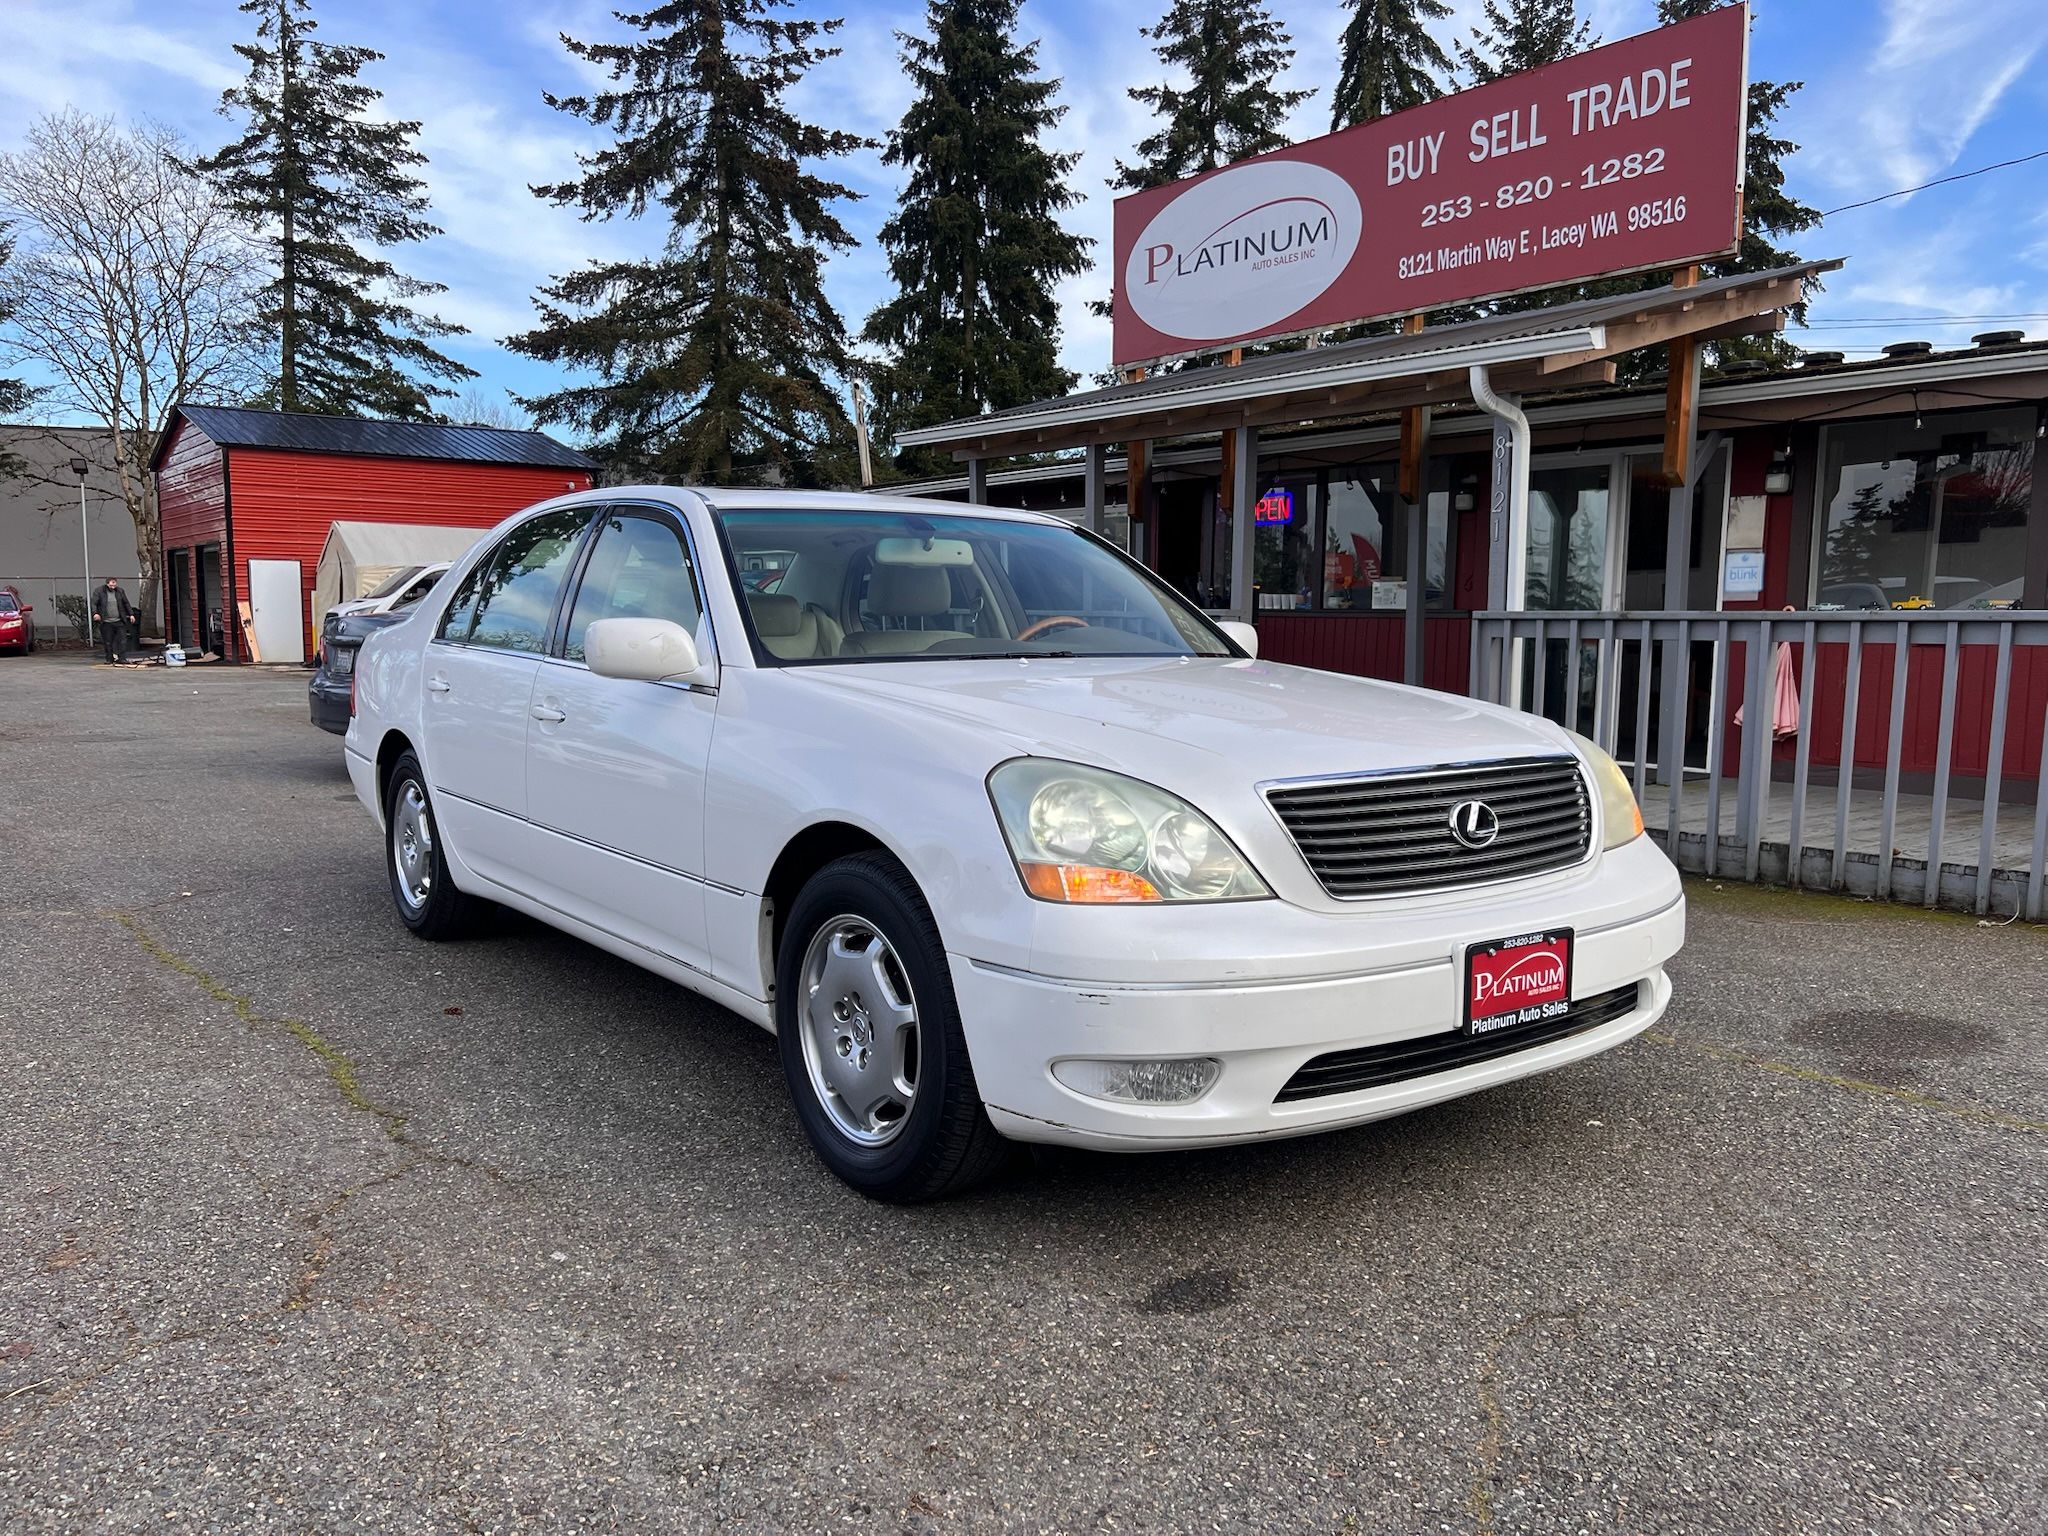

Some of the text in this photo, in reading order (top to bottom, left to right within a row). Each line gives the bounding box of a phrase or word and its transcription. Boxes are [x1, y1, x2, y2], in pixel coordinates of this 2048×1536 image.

[1387, 58, 1692, 187] BUY SELL TRADE
[1580, 147, 1665, 190] 1282
[1144, 216, 1329, 286] PLATINUM
[1398, 250, 1434, 280] 8121
[1437, 242, 1482, 272] Martin
[1484, 236, 1517, 263] Way
[1542, 222, 1587, 250] Lacey
[1590, 211, 1619, 239] WA
[1627, 195, 1688, 232] 98516
[1251, 248, 1316, 272] AUTO SALES INC
[1492, 436, 1505, 543] 8121
[1255, 497, 1290, 521] PEN
[1729, 568, 1758, 580] blink
[1503, 934, 1545, 949] 253-820-1282
[1473, 966, 1563, 1001] PLATINUM
[1471, 1001, 1569, 1035] Platinum Auto Sales
